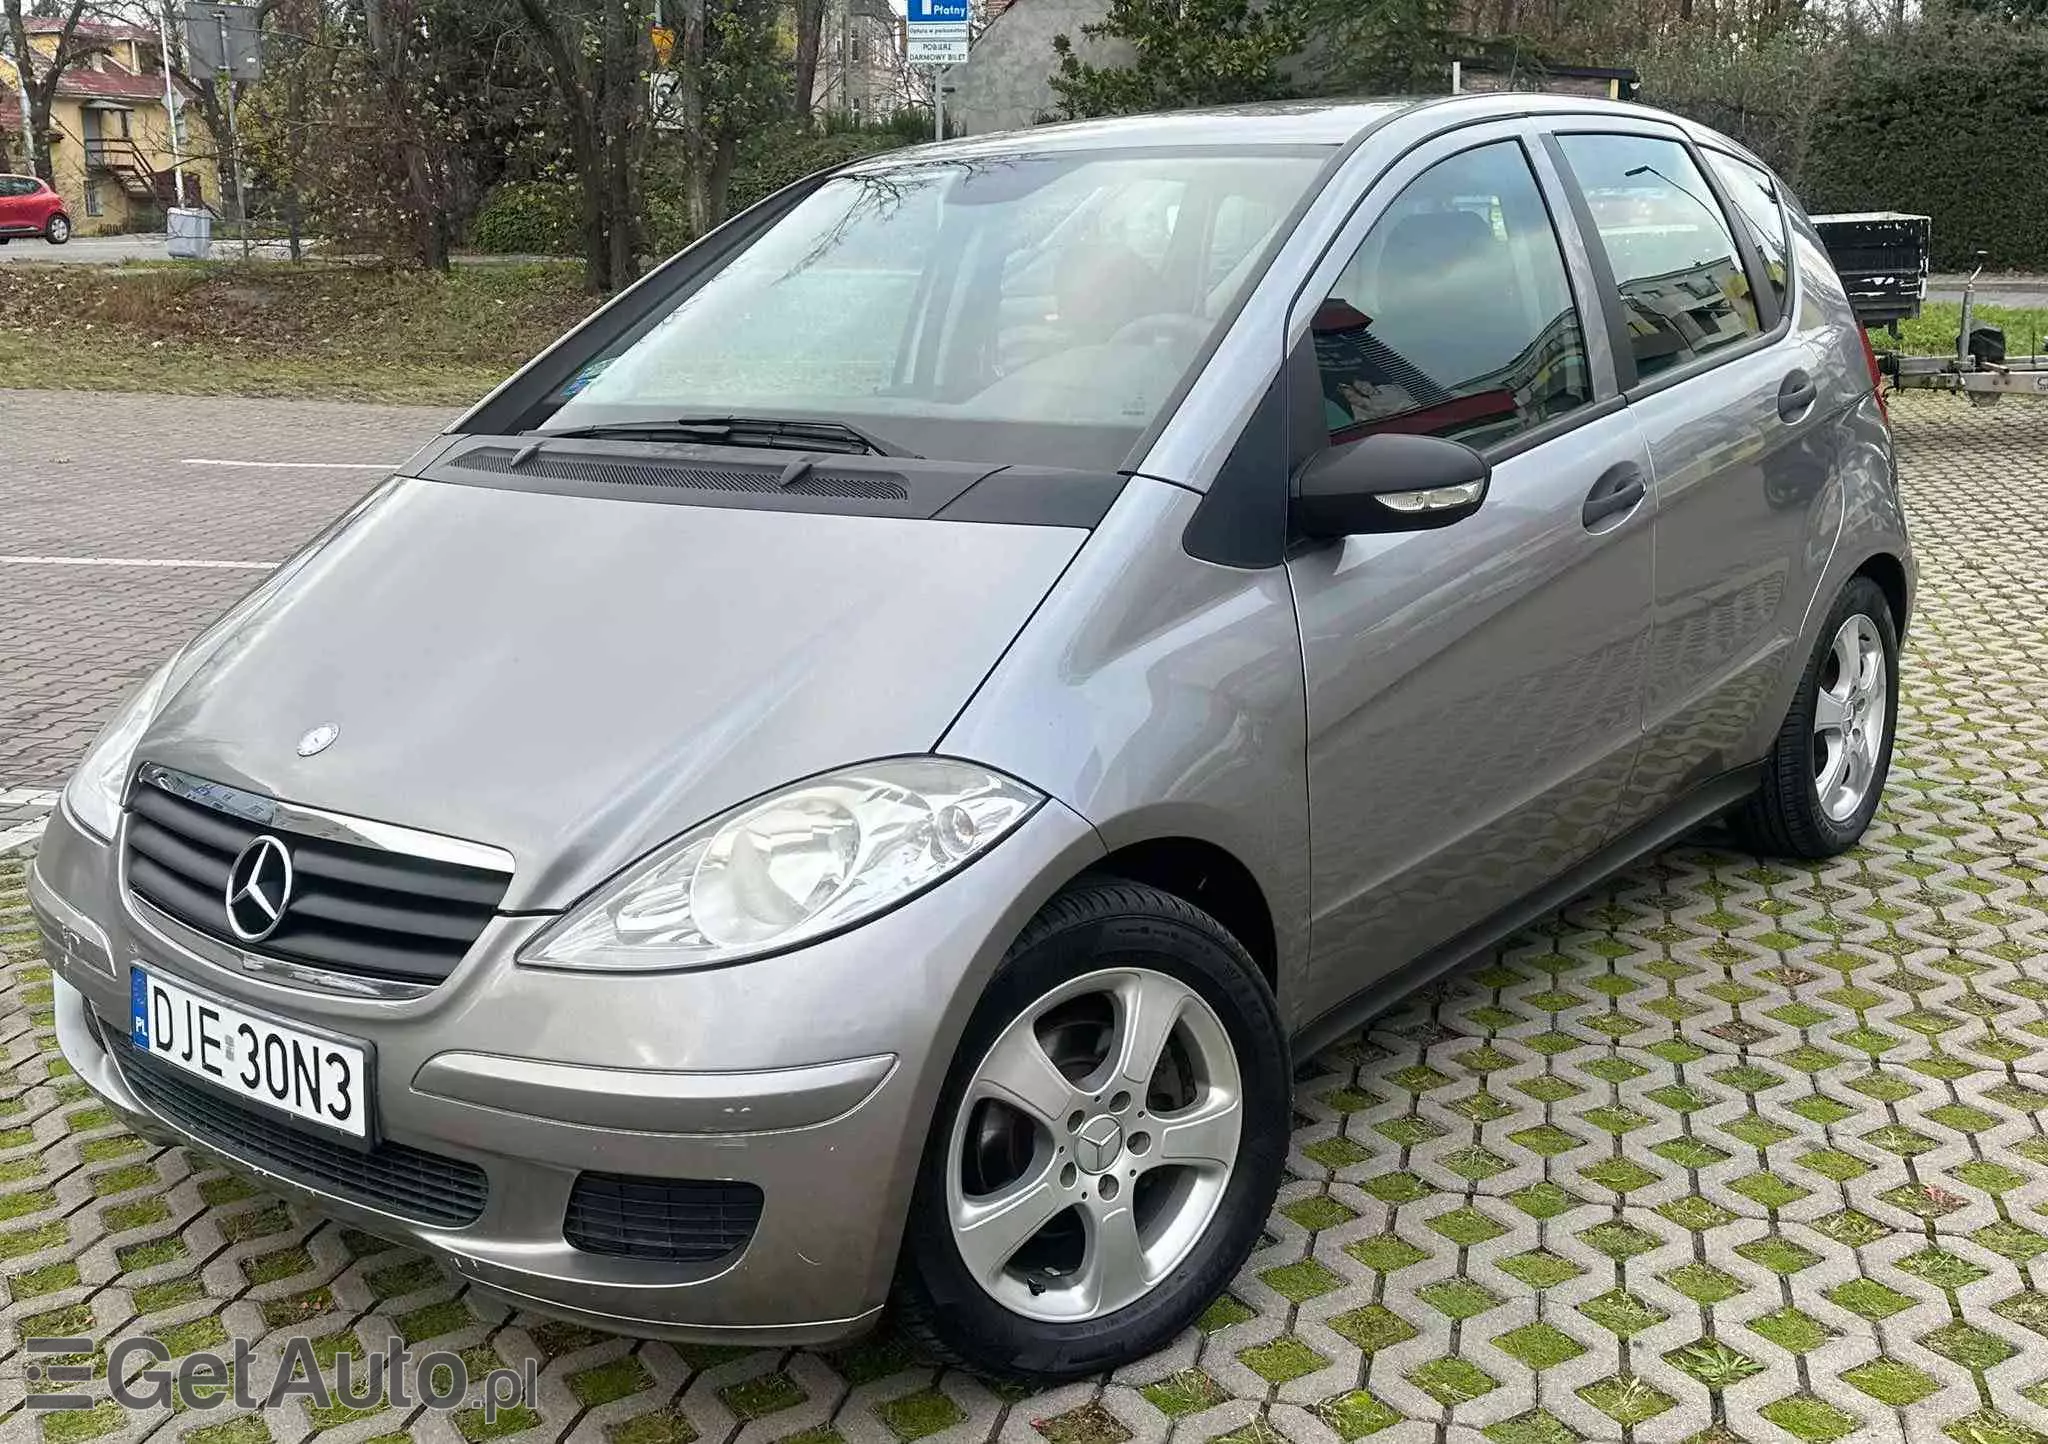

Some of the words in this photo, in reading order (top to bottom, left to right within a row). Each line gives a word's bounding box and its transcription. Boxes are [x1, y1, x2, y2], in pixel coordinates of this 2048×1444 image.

[934, 5, 966, 17] Płatny
[135, 1016, 147, 1037] PL
[153, 986, 222, 1077] DJE
[238, 1023, 351, 1121] 30N3
